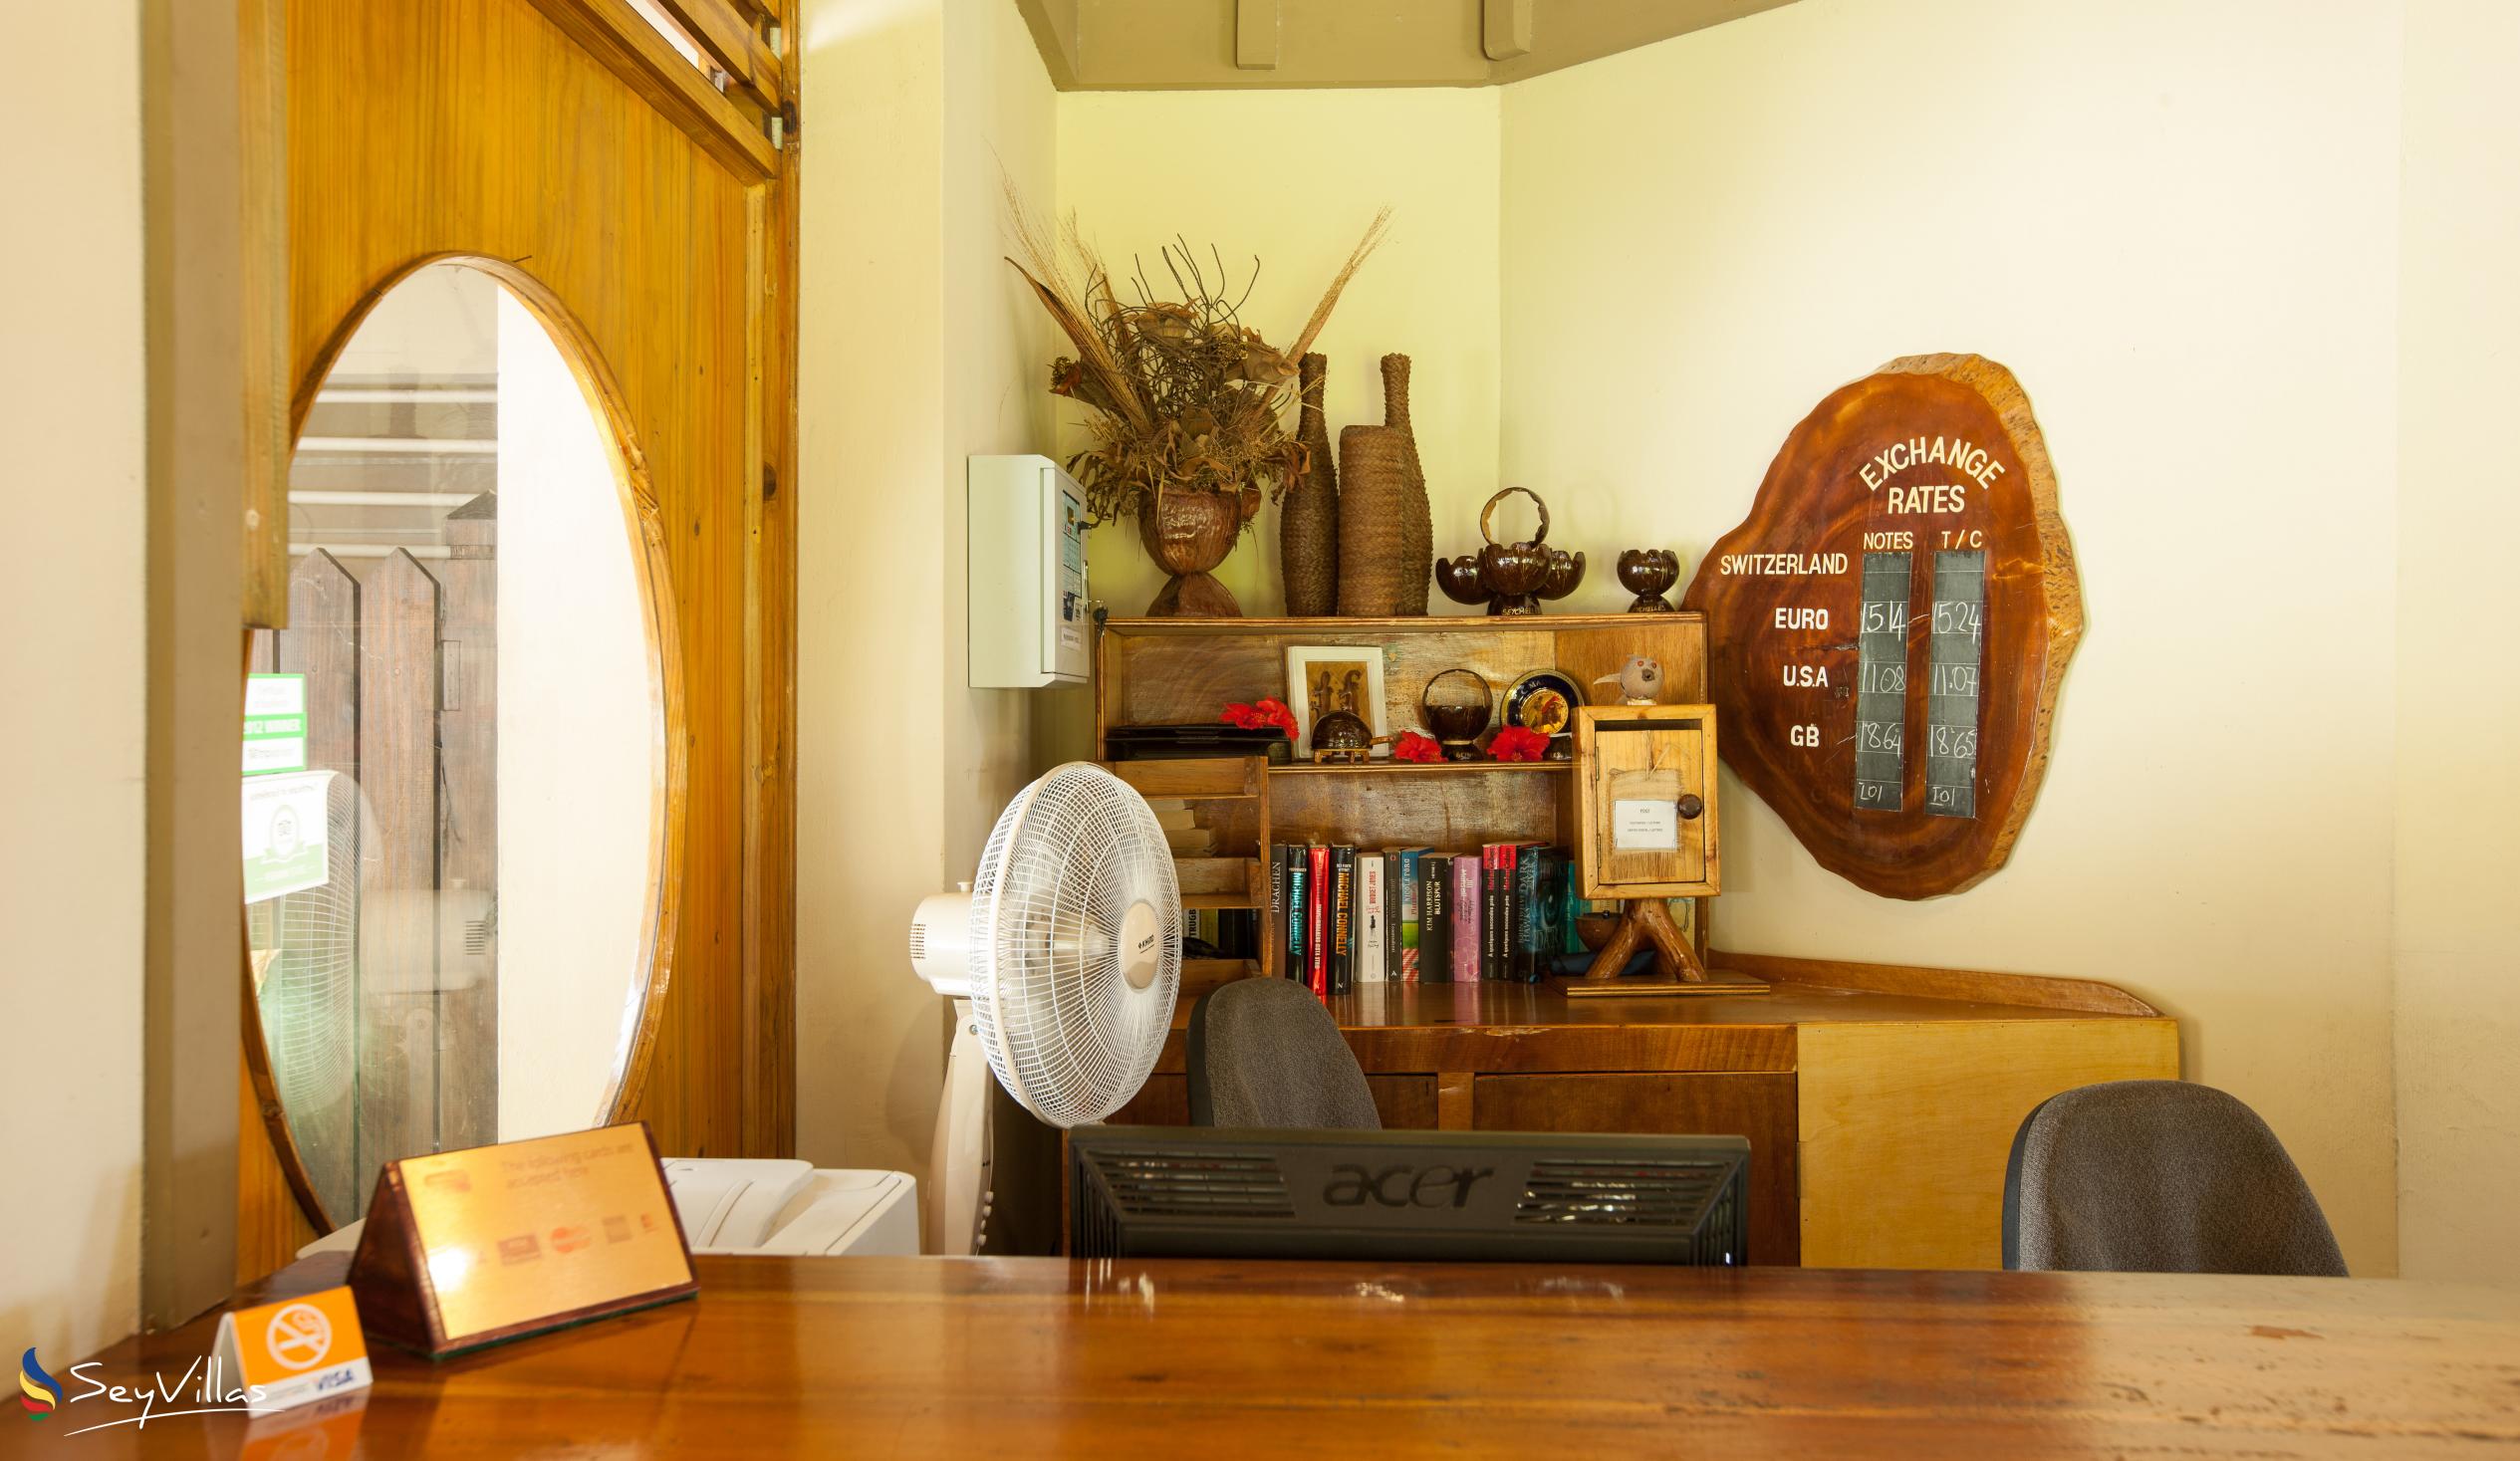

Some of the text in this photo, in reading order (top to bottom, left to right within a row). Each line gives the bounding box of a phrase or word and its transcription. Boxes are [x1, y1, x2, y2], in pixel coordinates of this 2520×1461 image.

[1859, 436, 2005, 491] EXCHANGE
[1888, 485, 1965, 514] RATES
[1863, 531, 1913, 550] NOTES
[1720, 553, 1849, 575] SWITZERLAND
[1775, 608, 1829, 629] EURO
[1790, 725, 1820, 747] GB
[1270, 861, 1281, 913] DRACHEN
[1337, 872, 1350, 908] MICHAEL
[1336, 912, 1348, 956] CONNELLY
[1323, 1163, 1495, 1208] acer
